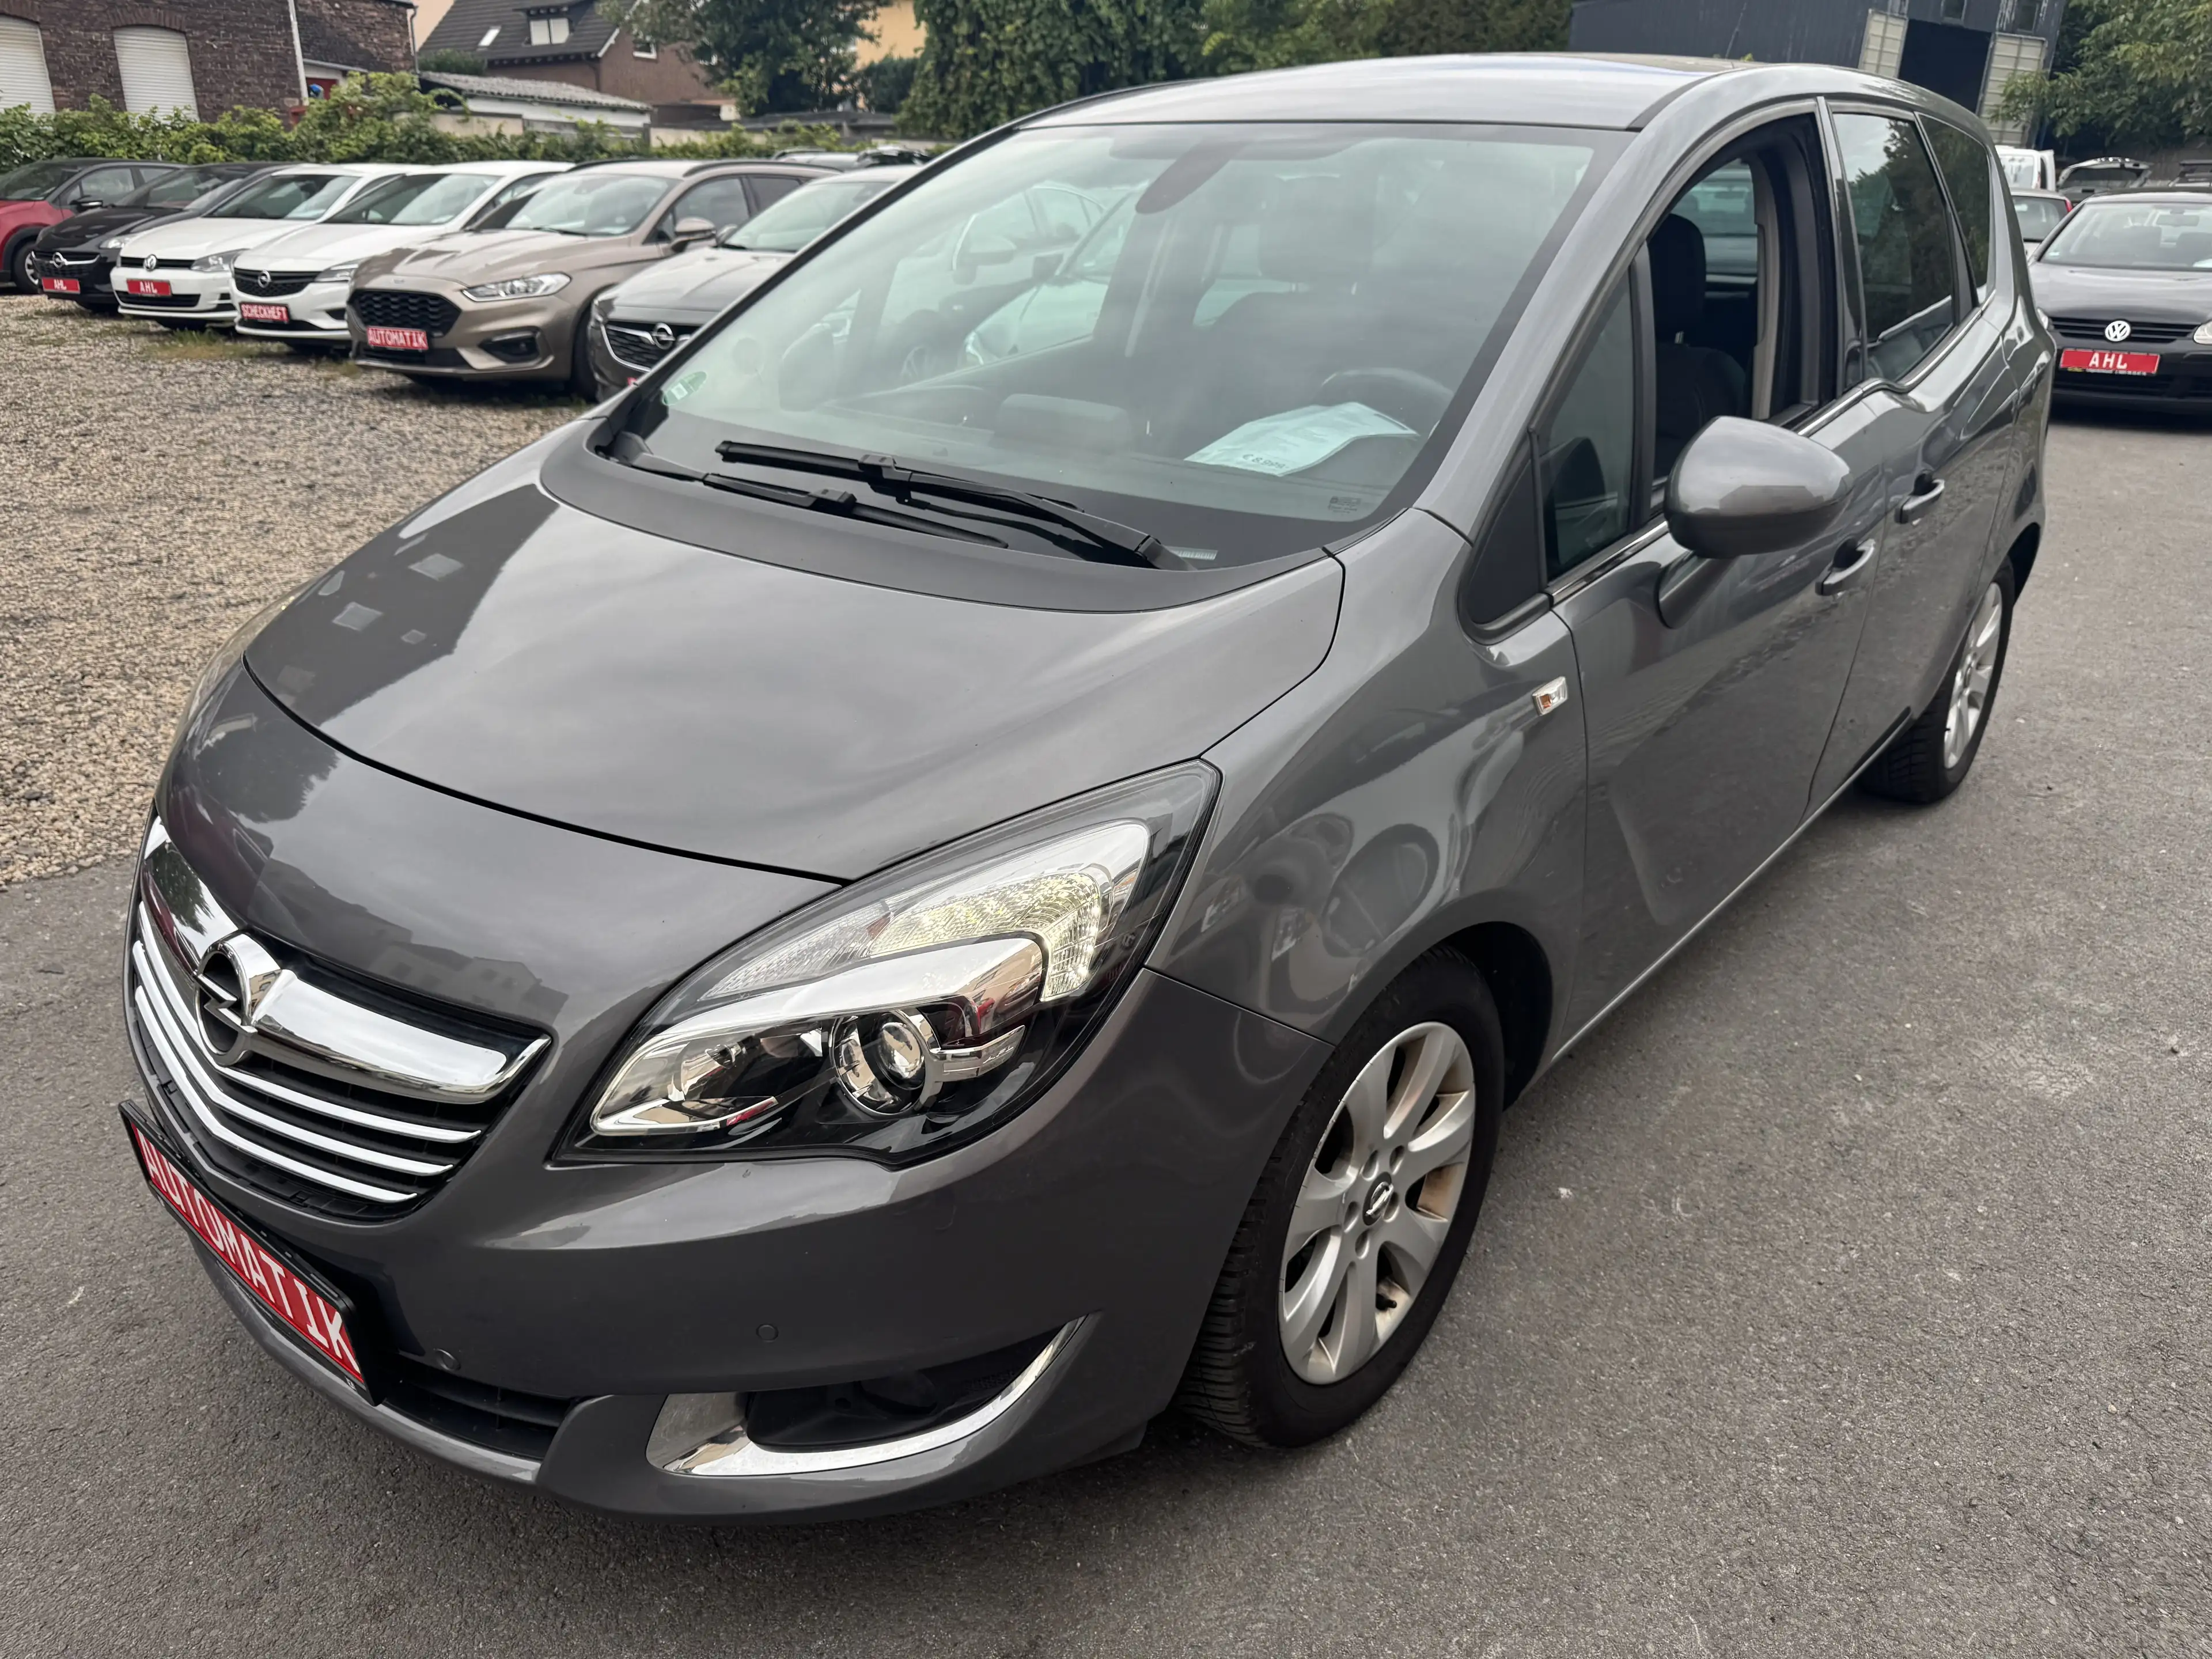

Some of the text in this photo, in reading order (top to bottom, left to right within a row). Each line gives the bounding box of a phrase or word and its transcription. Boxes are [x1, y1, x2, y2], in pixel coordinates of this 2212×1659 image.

[54, 279, 67, 290] AHL
[140, 281, 157, 293] AHL
[241, 304, 287, 320] SCHECKHEFT
[368, 329, 427, 348] AUTOMATIK
[2089, 352, 2128, 369] AHL
[137, 1128, 361, 1374] AUTOMATIK
